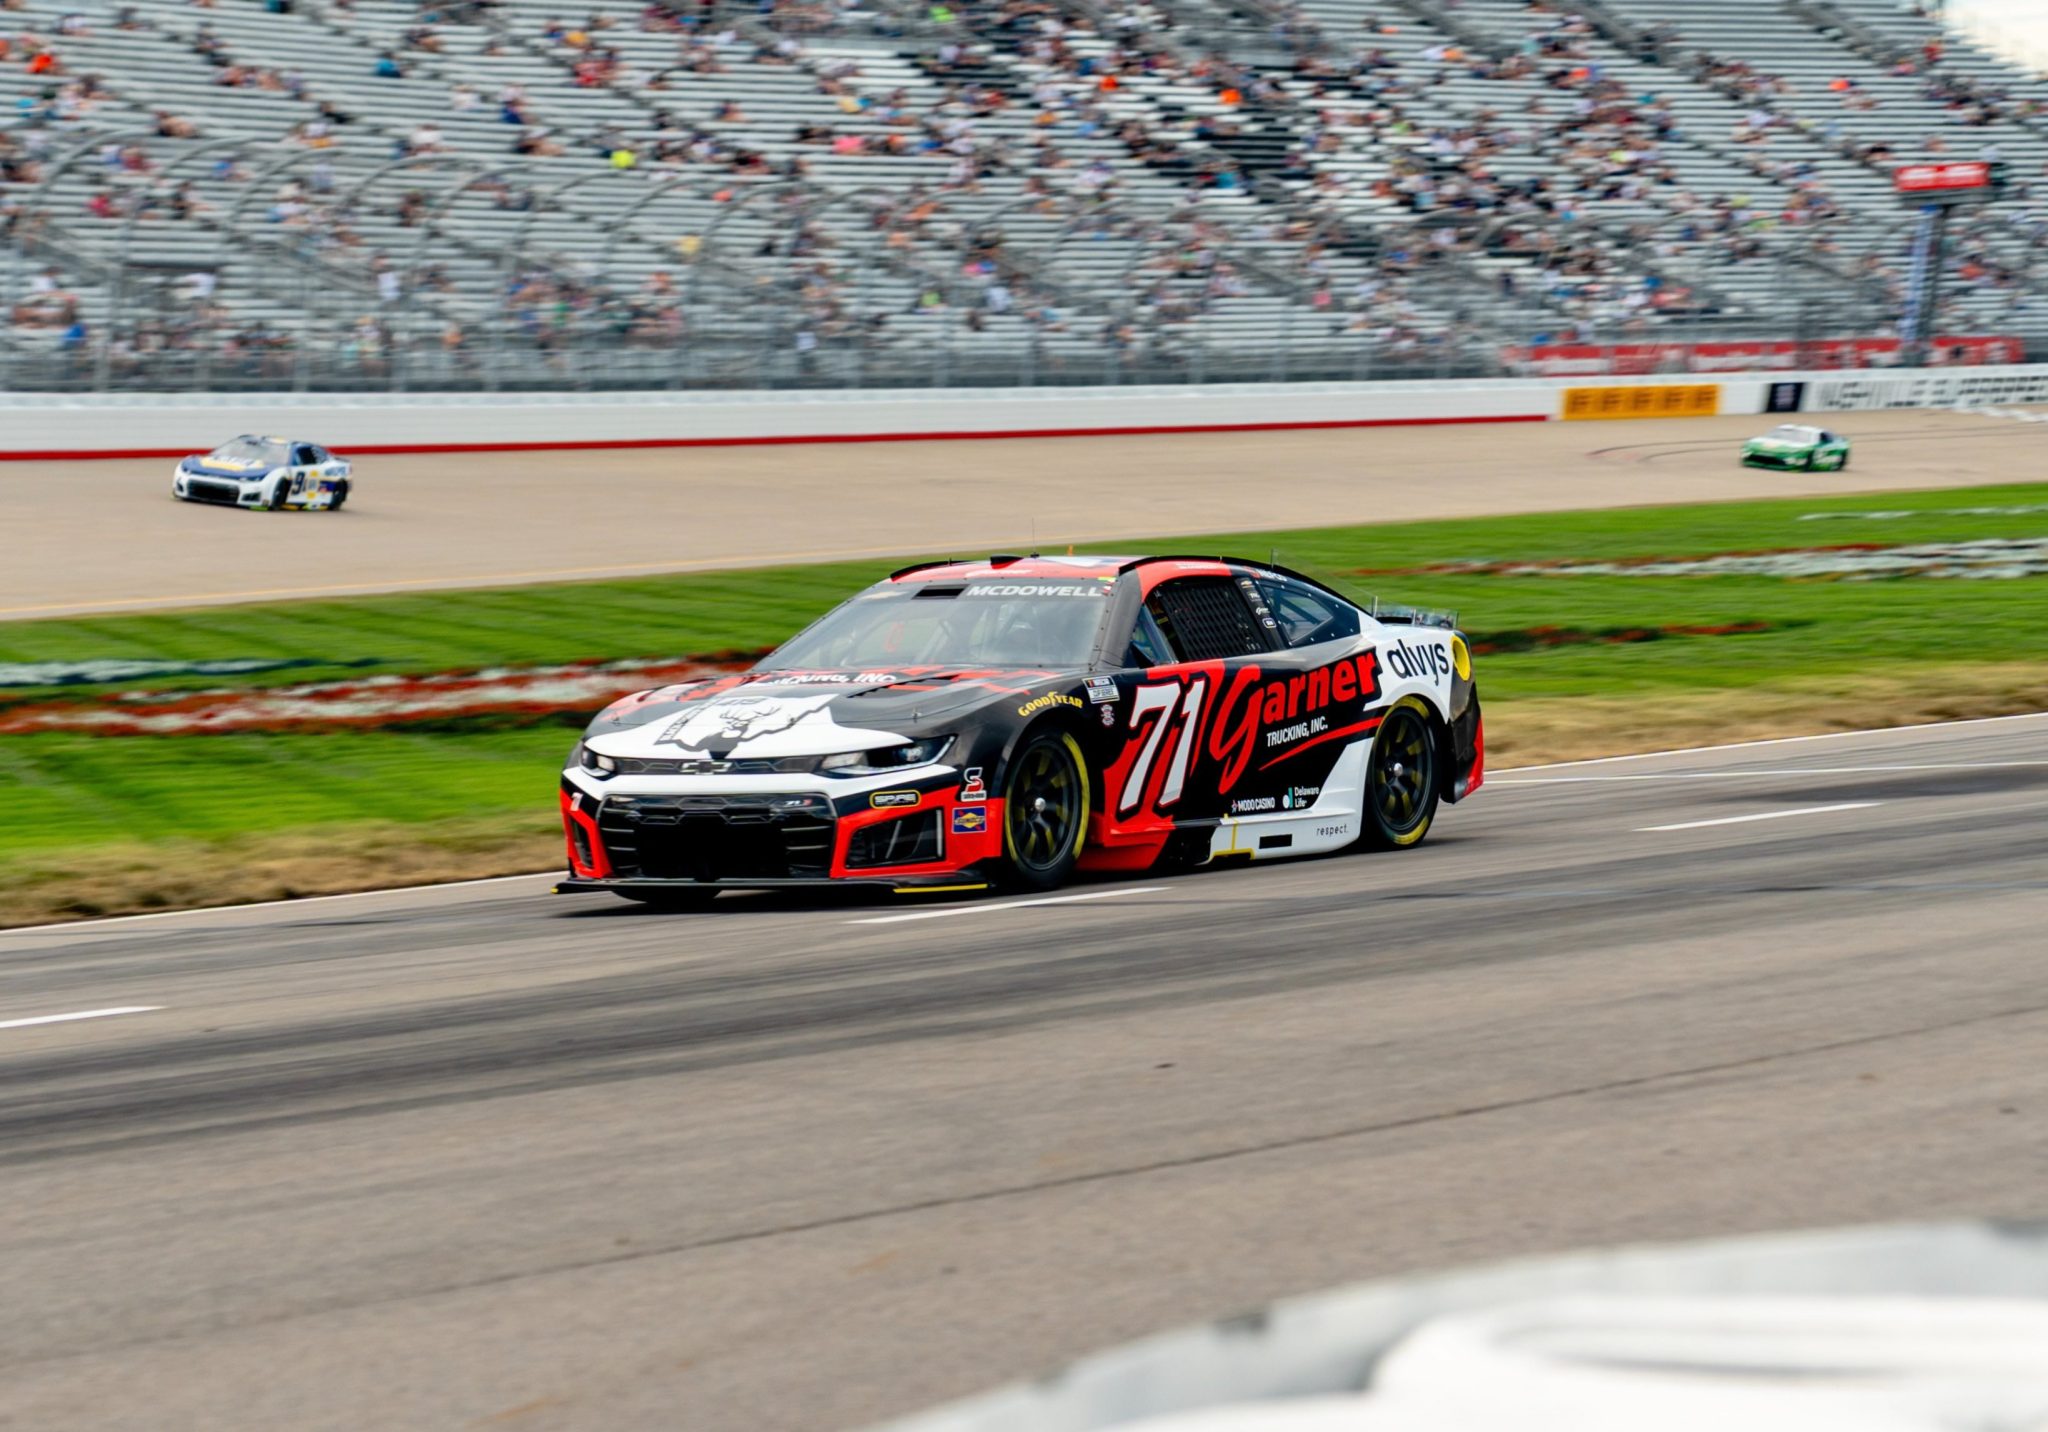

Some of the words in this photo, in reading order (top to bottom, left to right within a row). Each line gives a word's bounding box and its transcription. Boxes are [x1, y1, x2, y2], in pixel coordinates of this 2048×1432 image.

[966, 585, 1103, 597] MCDOWELL
[1387, 639, 1449, 686] alvys
[1210, 652, 1377, 795] Garner
[1266, 721, 1310, 747] TRUCKING,
[1310, 716, 1328, 734] INC.
[1119, 677, 1205, 812] 71
[1294, 786, 1319, 796] Delaware
[1237, 799, 1256, 811] MODO
[1255, 797, 1275, 809] CASINO
[1294, 799, 1307, 808] Life
